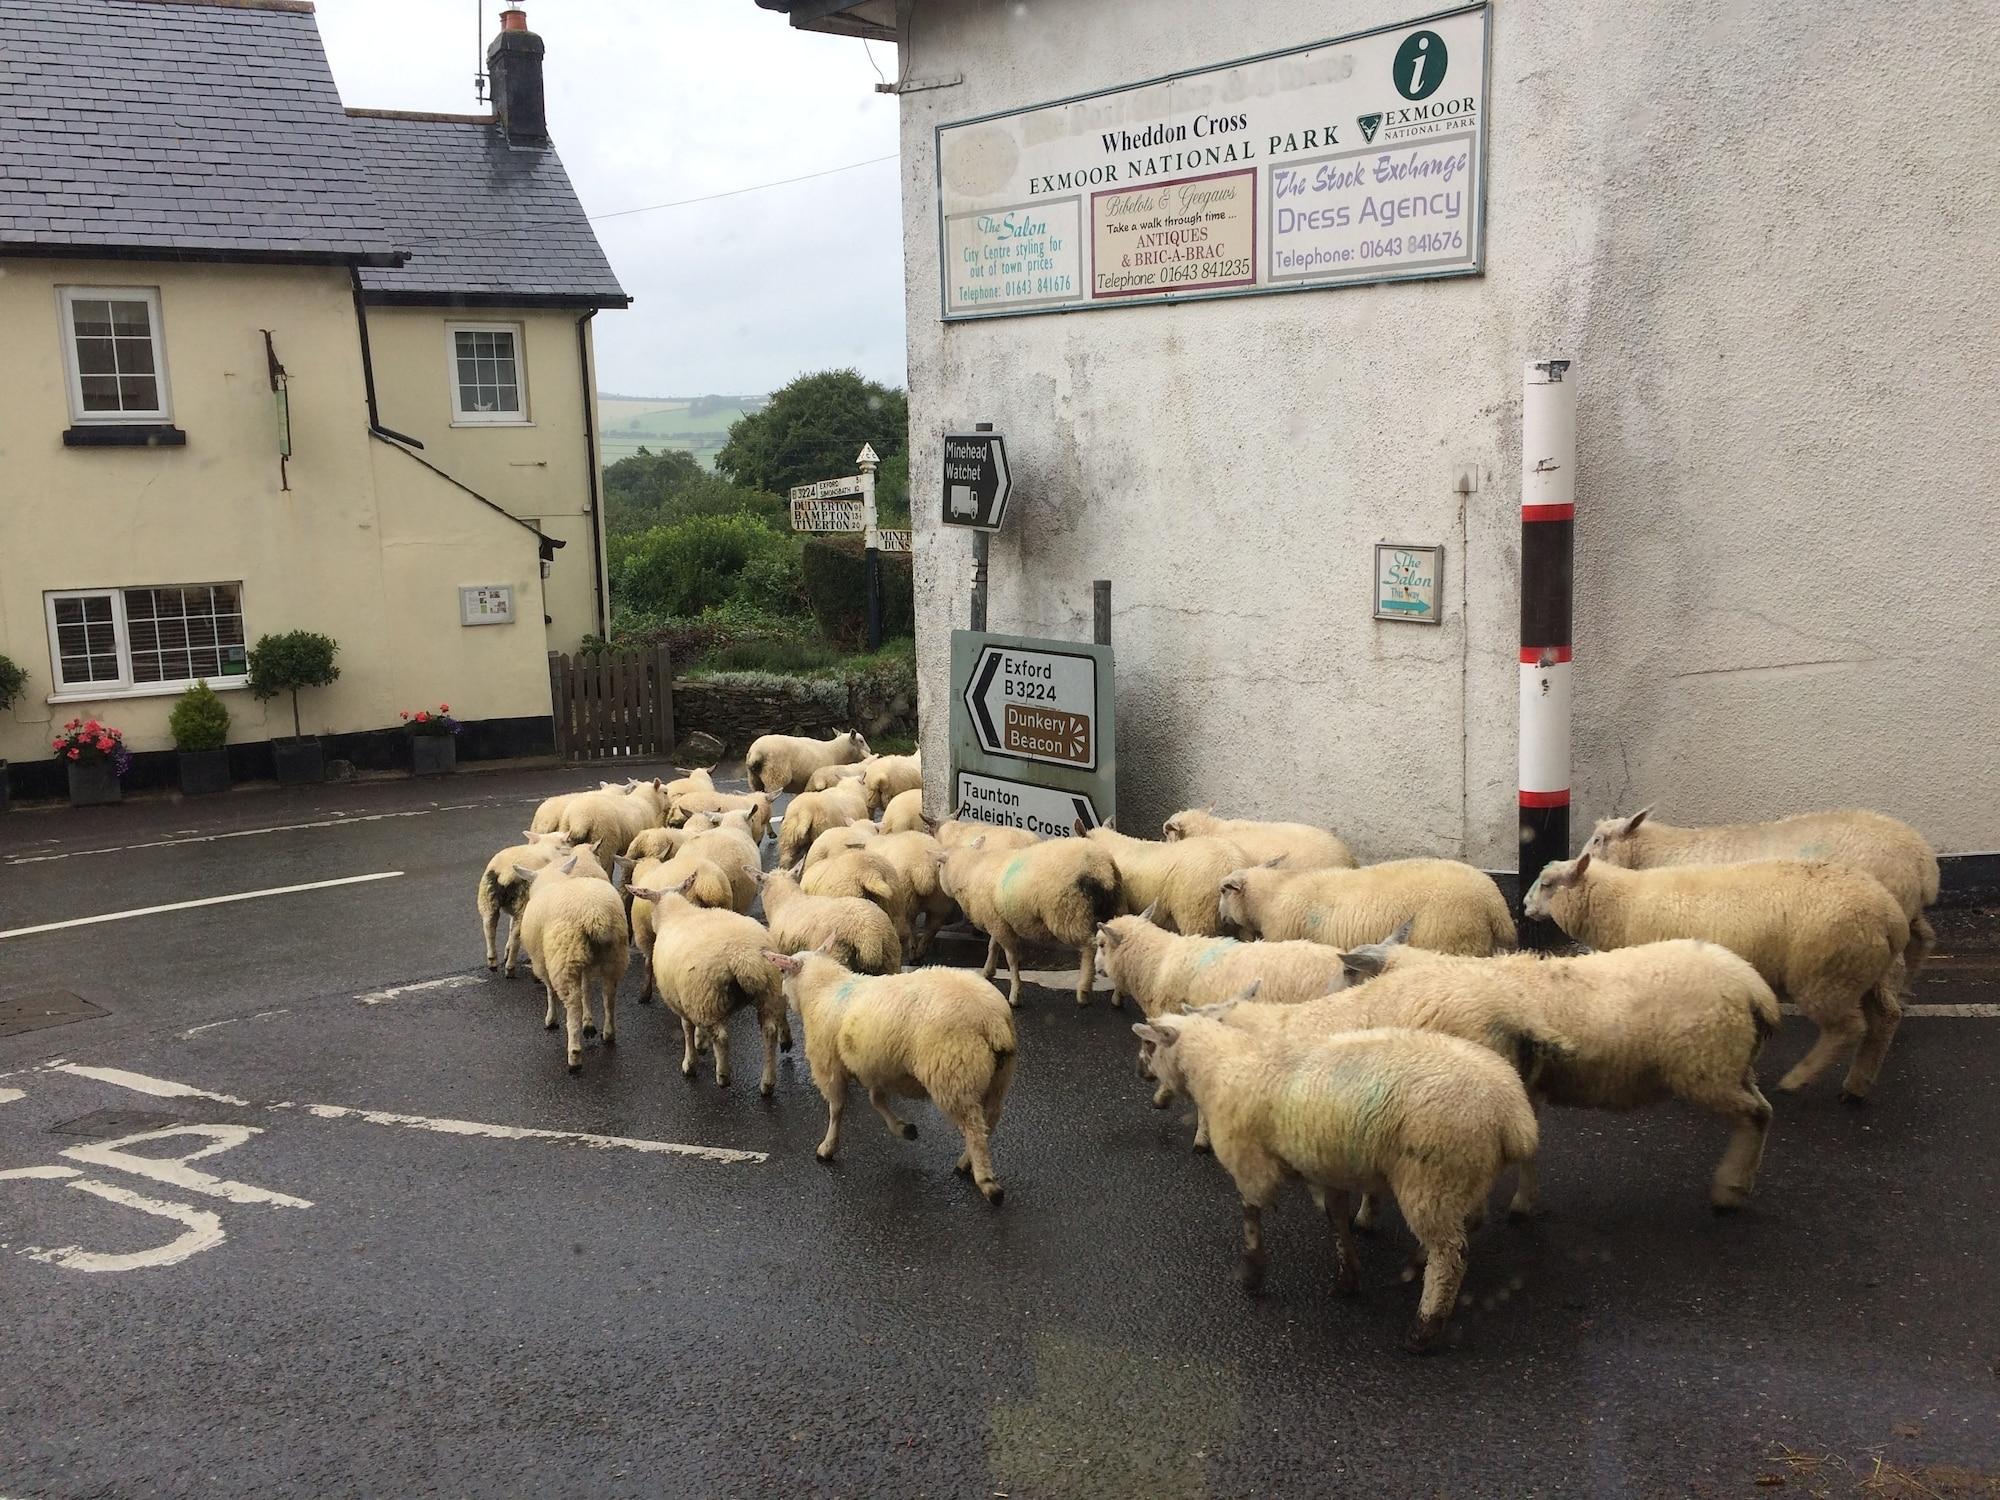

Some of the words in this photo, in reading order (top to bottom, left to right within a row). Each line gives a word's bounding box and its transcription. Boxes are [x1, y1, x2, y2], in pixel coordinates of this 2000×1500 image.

[1385, 97, 1476, 126] EXMOOR
[1101, 123, 1187, 154] Wheddon
[1192, 112, 1248, 139] Cross
[1384, 124, 1441, 140] NATIONAL
[1446, 117, 1476, 130] PARK
[1029, 164, 1119, 195] EXMOOR
[1128, 140, 1256, 179] NATIONAL
[1268, 124, 1340, 155] PARK
[1274, 170, 1306, 199] The
[1312, 161, 1366, 192] Stock
[1372, 152, 1468, 184] Exchange
[1105, 195, 1154, 217] Bibelots
[1158, 187, 1171, 209] &
[1178, 184, 1237, 216] Geegaws
[1278, 206, 1351, 234] Dress
[1358, 190, 1462, 227] Agency
[977, 216, 1000, 234] The
[997, 212, 1047, 240] Salon
[1106, 223, 1129, 234] Take
[1140, 217, 1162, 230] walk
[1164, 211, 1202, 227] through
[1205, 211, 1226, 222] time
[963, 247, 979, 265] City
[984, 244, 1011, 260] Centre
[1016, 239, 1045, 260] styling
[1049, 235, 1063, 252] for
[1137, 227, 1208, 249] ANTIQUES
[1276, 247, 1355, 271] Telephone:
[1359, 237, 1403, 259] 01643
[1407, 230, 1463, 254] 841676
[970, 264, 984, 278] out
[988, 260, 998, 276] of
[1002, 260, 1022, 274] town
[1027, 256, 1053, 275] prices
[1121, 254, 1131, 268] &
[1135, 243, 1225, 267] BRIC-A-BRAC
[1098, 272, 1156, 290] Telephone:
[1160, 263, 1198, 283] 01643
[1201, 258, 1250, 278] 841235
[960, 285, 1002, 304] Telephone:
[1006, 279, 1032, 297] 01643
[1037, 274, 1071, 294] 841676
[946, 441, 988, 462] Minehead
[945, 462, 982, 481] Watchet
[820, 480, 840, 490] EXFORD
[794, 501, 853, 511] DULVERTON
[794, 511, 851, 520] BAMPTON
[795, 520, 850, 530] TIVERTON
[1394, 550, 1422, 568] The
[1382, 565, 1432, 587] Salon
[1005, 657, 1052, 679] Exford
[1008, 708, 1066, 736] Dunkery
[1010, 730, 1063, 754] Beacon
[963, 780, 1020, 807] Taunton
[963, 801, 1024, 829] Raleigh's
[1027, 815, 1070, 838] Cross
